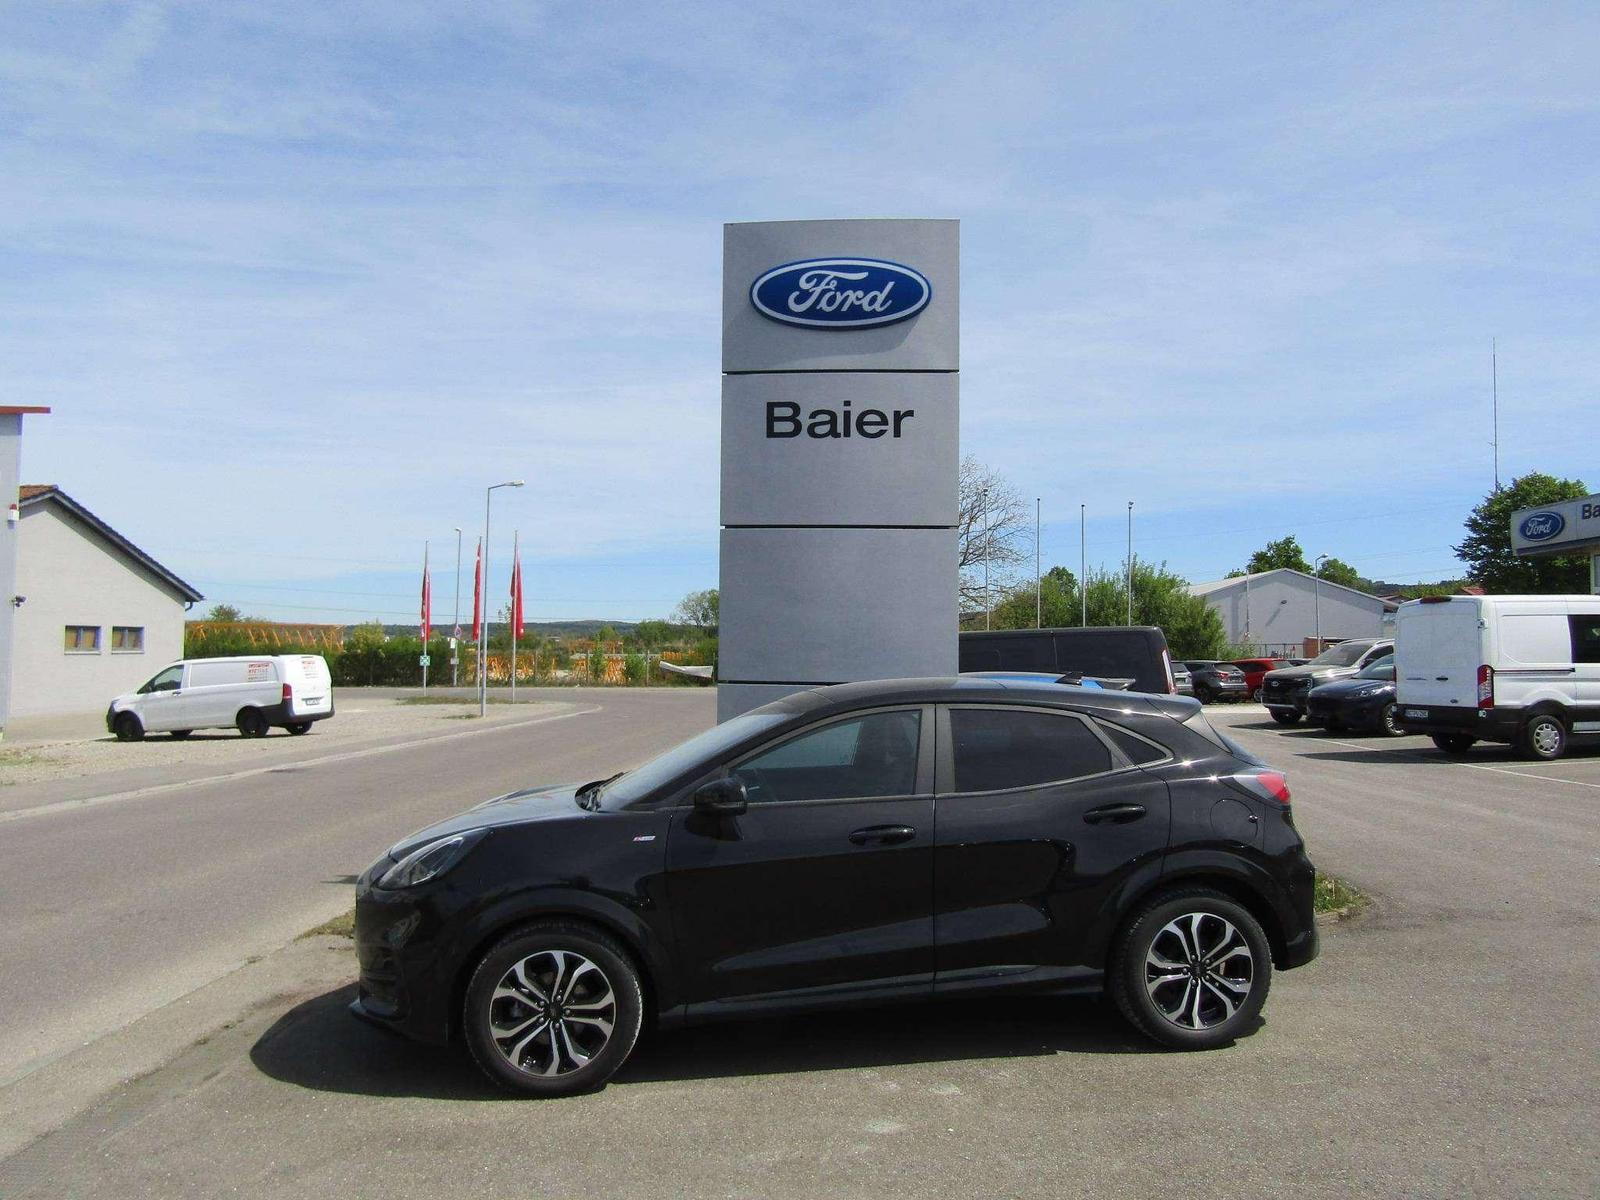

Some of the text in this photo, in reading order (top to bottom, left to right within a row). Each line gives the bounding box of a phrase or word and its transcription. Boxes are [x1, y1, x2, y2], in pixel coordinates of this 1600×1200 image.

[788, 270, 895, 313] Ford
[766, 401, 915, 439] Baier
[1526, 516, 1552, 536] Ford
